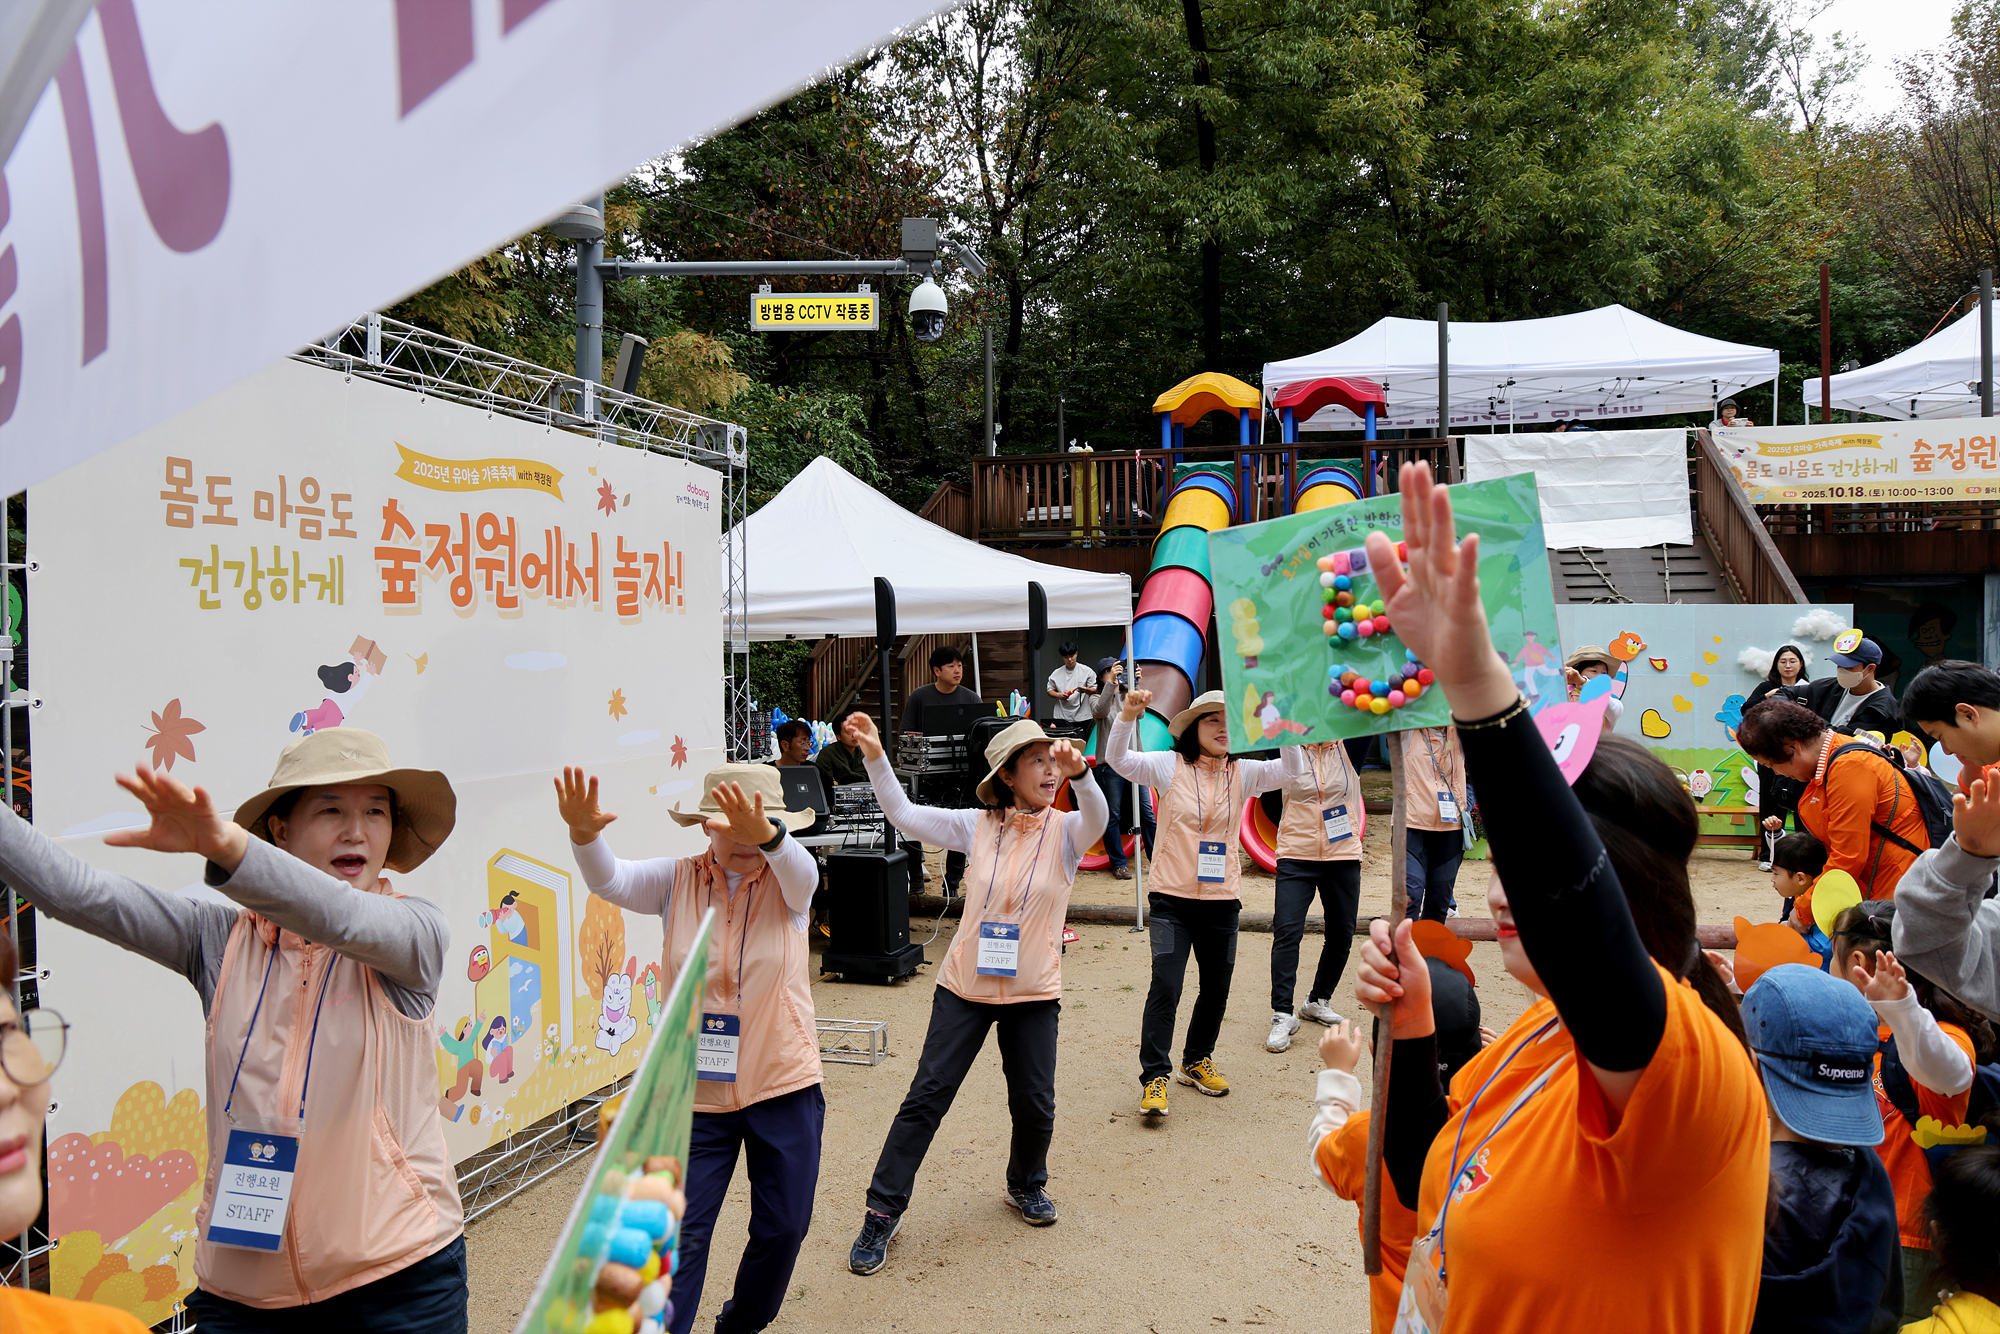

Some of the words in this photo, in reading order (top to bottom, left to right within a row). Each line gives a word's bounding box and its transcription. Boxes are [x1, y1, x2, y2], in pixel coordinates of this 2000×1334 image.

[761, 304, 795, 321] 방범용
[799, 304, 832, 319] CCTV
[836, 303, 870, 320] 작동중
[1767, 445, 1791, 454] 2025년
[1910, 435, 2000, 472] 숲정원
[413, 460, 450, 483] 2025년
[452, 467, 480, 485] 유아숲
[481, 465, 517, 482] 가족축제
[517, 470, 533, 481] with
[533, 472, 552, 487] 책정원
[1745, 460, 1773, 478] 몸도
[1779, 459, 1825, 478] 마음도
[1828, 457, 1898, 478] 건강하게
[160, 456, 238, 529] 몸도
[253, 474, 357, 541] 마음도
[687, 481, 709, 501] dobong
[1887, 486, 1954, 497] 10:00~13:00
[1282, 537, 1321, 581] 호기심이
[1321, 515, 1359, 541] 가득한
[1364, 511, 1401, 528] 방학3
[374, 498, 599, 609] 숲정원에서
[613, 533, 684, 616] 놀자!
[179, 544, 344, 611] 건강하게
[987, 941, 1012, 950] 진행요원
[984, 956, 1011, 965] STAFF
[699, 1037, 731, 1048] 진행요원
[697, 1056, 729, 1067] STAFF
[1818, 1063, 1865, 1081] Supreme
[234, 1172, 280, 1191] 진행요원
[226, 1203, 274, 1223] STAFF
